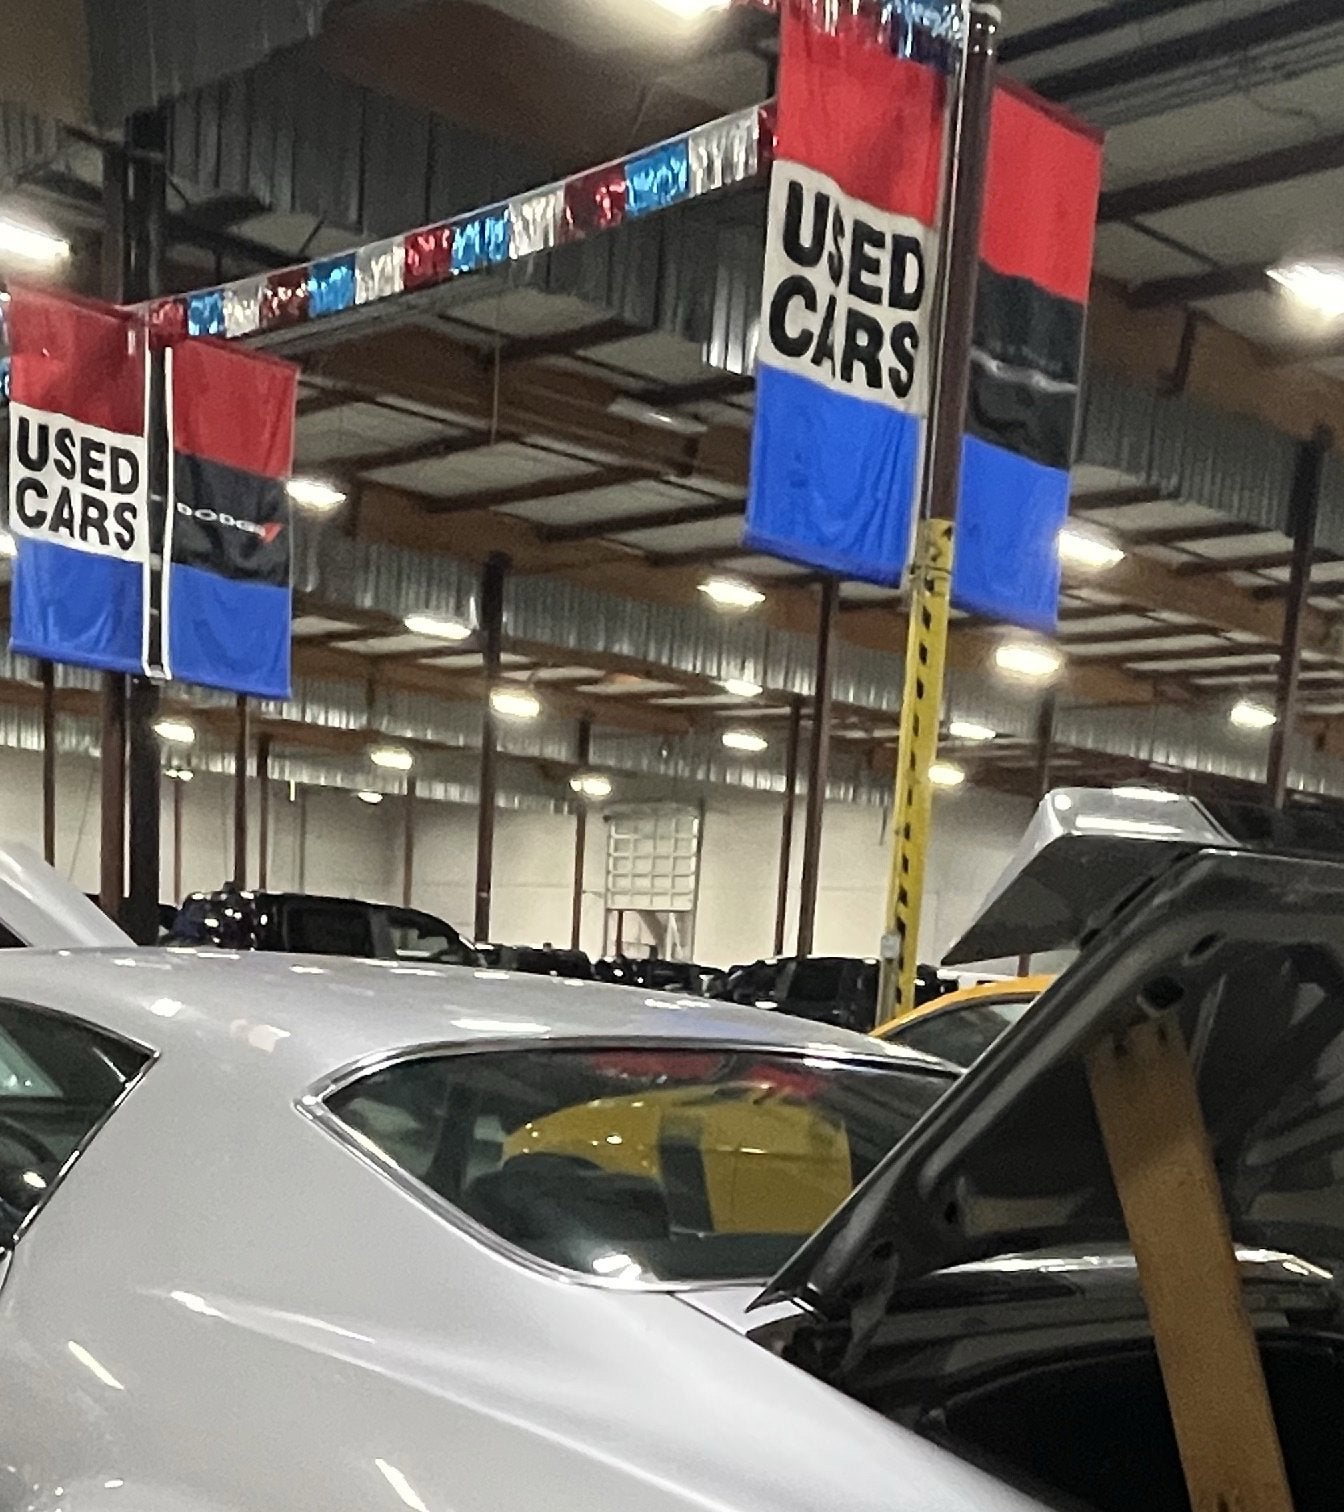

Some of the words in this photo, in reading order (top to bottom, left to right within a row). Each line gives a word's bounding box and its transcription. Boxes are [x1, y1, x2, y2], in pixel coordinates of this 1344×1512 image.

[781, 180, 925, 311] USED
[768, 276, 919, 400] CARS
[17, 417, 140, 495] USED
[16, 477, 138, 551] CARS
